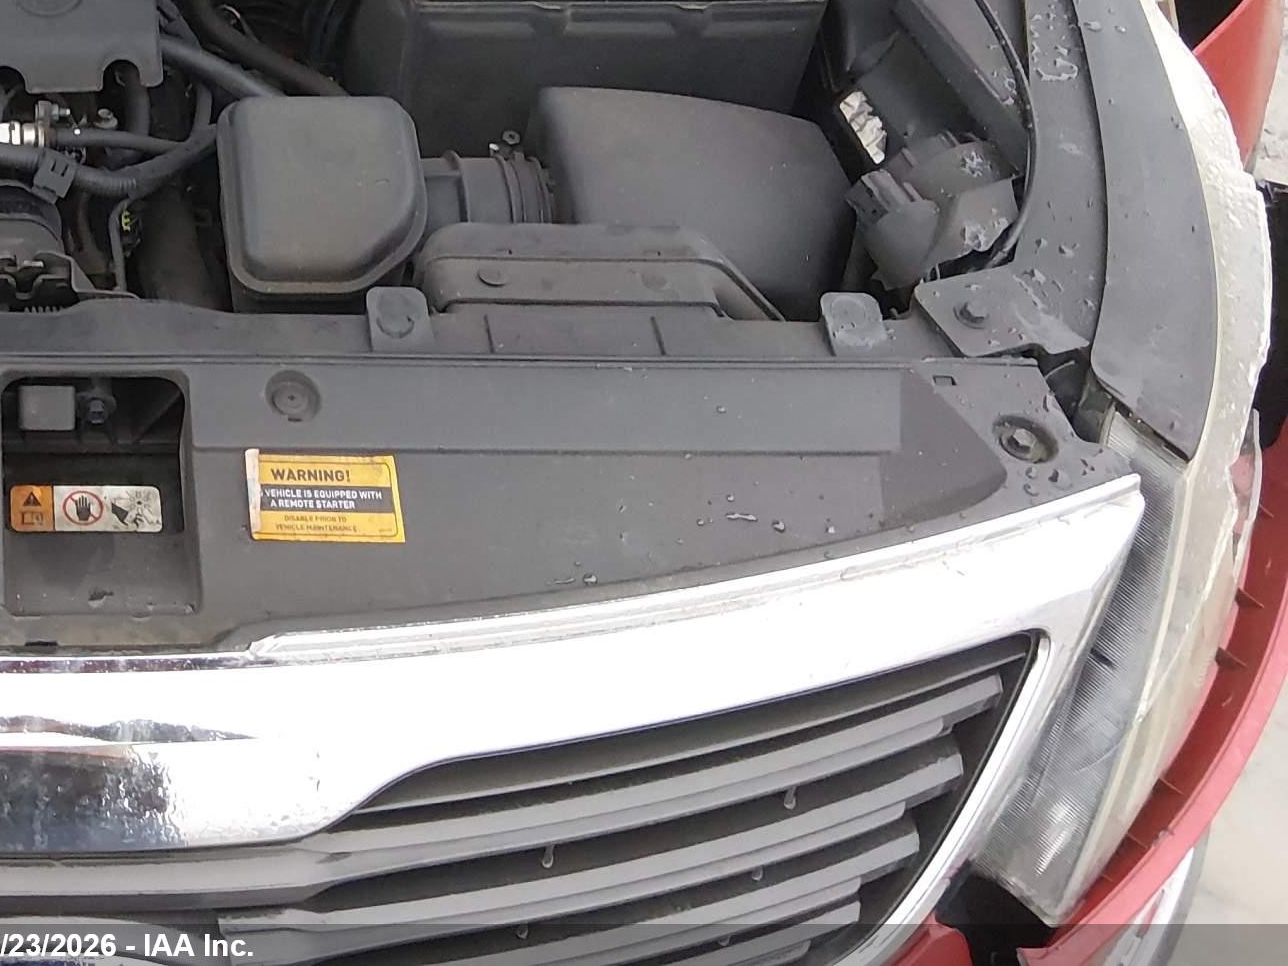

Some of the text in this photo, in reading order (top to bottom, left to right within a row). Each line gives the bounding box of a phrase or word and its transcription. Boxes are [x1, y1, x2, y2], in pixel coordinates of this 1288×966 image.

[270, 468, 351, 483] WARNING!
[265, 488, 302, 498] VEHICLE
[304, 489, 312, 498] IS
[314, 489, 358, 499] EQUIPPED
[359, 490, 383, 500] WITH
[270, 499, 356, 509] A REMOTE STARTER
[338, 515, 347, 523] TO
[275, 523, 358, 533] VEHICLE MAINTENANCE
